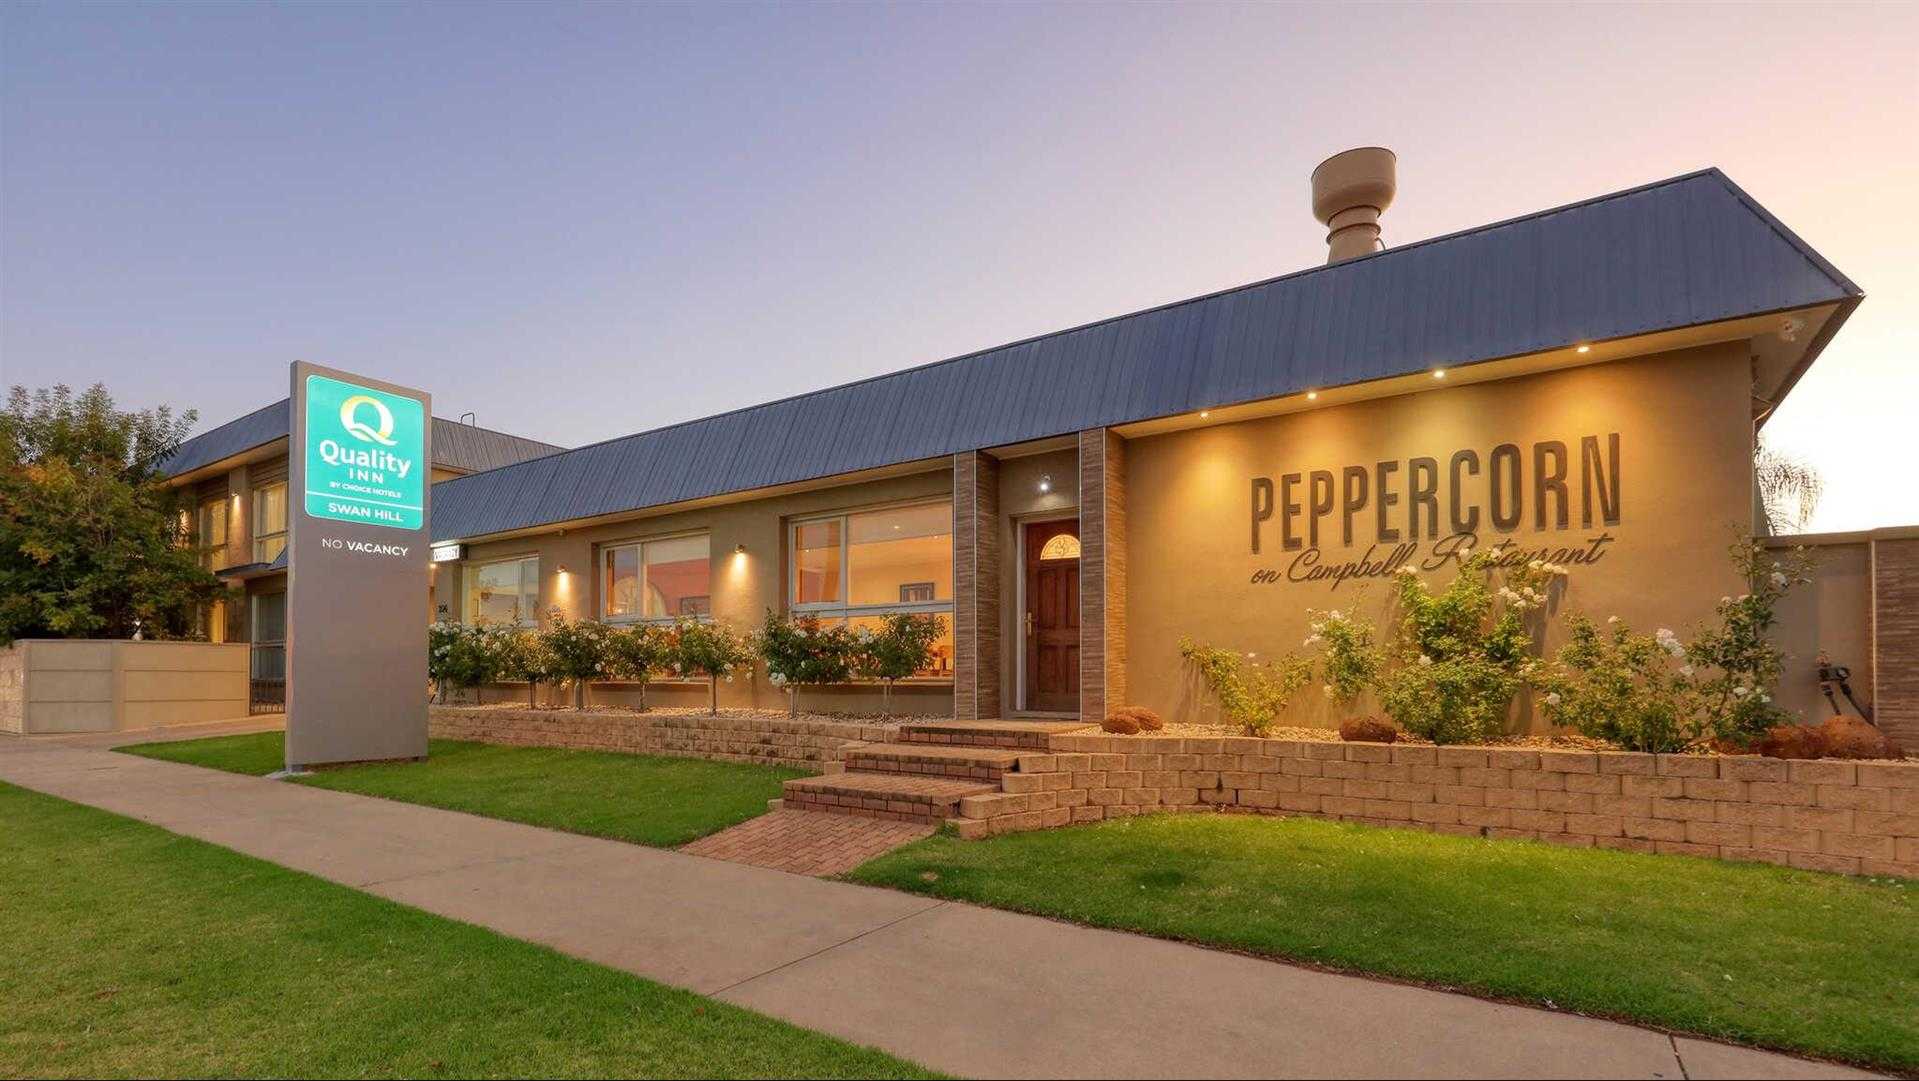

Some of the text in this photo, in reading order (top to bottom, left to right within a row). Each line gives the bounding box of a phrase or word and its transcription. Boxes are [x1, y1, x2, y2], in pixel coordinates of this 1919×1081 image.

[319, 439, 411, 478] Quality
[349, 467, 384, 484] INN
[1250, 432, 1621, 554] PEPPERCORN
[328, 502, 404, 522] SWAN HILL
[322, 538, 408, 556] NO VACANCY
[1251, 531, 1615, 592] on Campbell Rtaurant
